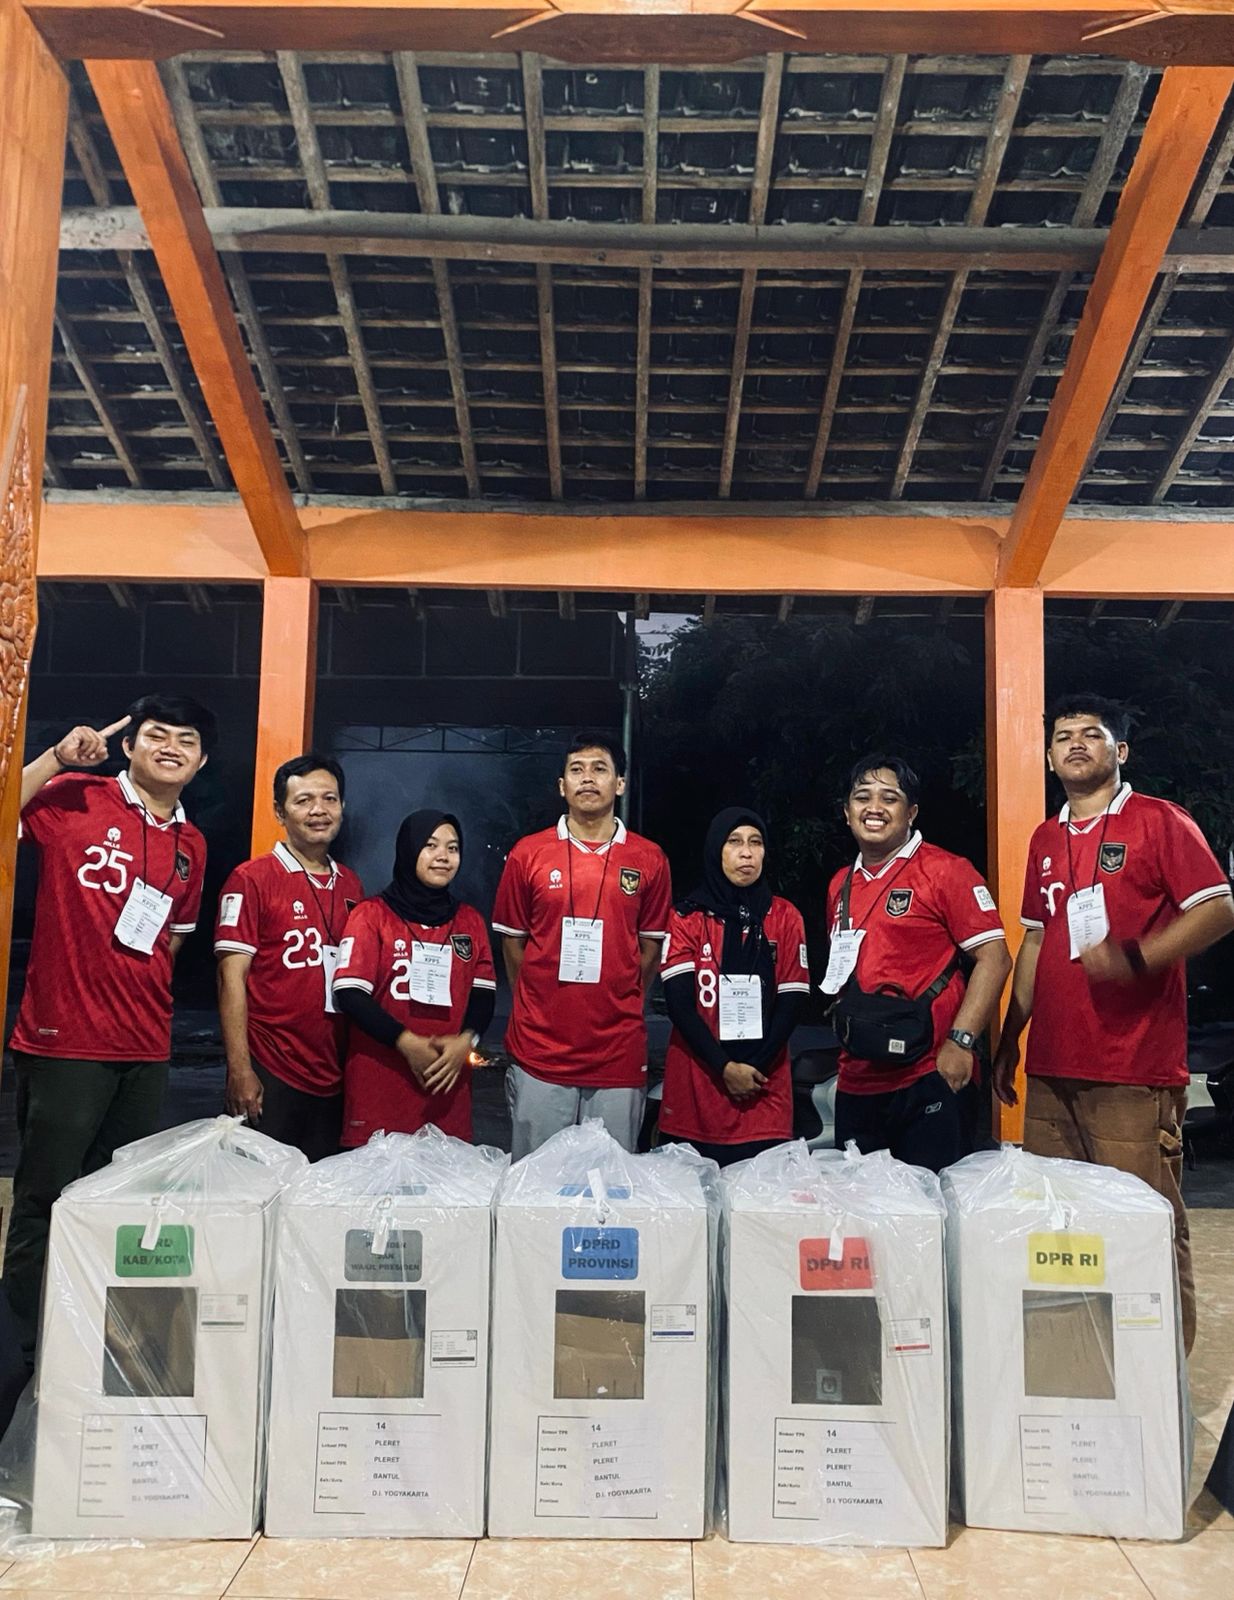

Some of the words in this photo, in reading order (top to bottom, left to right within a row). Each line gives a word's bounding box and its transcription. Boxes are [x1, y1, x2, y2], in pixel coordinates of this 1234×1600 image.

[78, 846, 133, 894] 25
[282, 927, 324, 970] 23
[698, 969, 716, 1008] 8
[582, 1239, 620, 1250] DPRD
[123, 1255, 186, 1265] KAB/KOTA
[568, 1258, 634, 1268] PROVINSI
[850, 1256, 869, 1270] RI
[1036, 1252, 1074, 1266] DPR
[1080, 1254, 1098, 1266] RI
[608, 1487, 652, 1497] YOGYAKARTA
